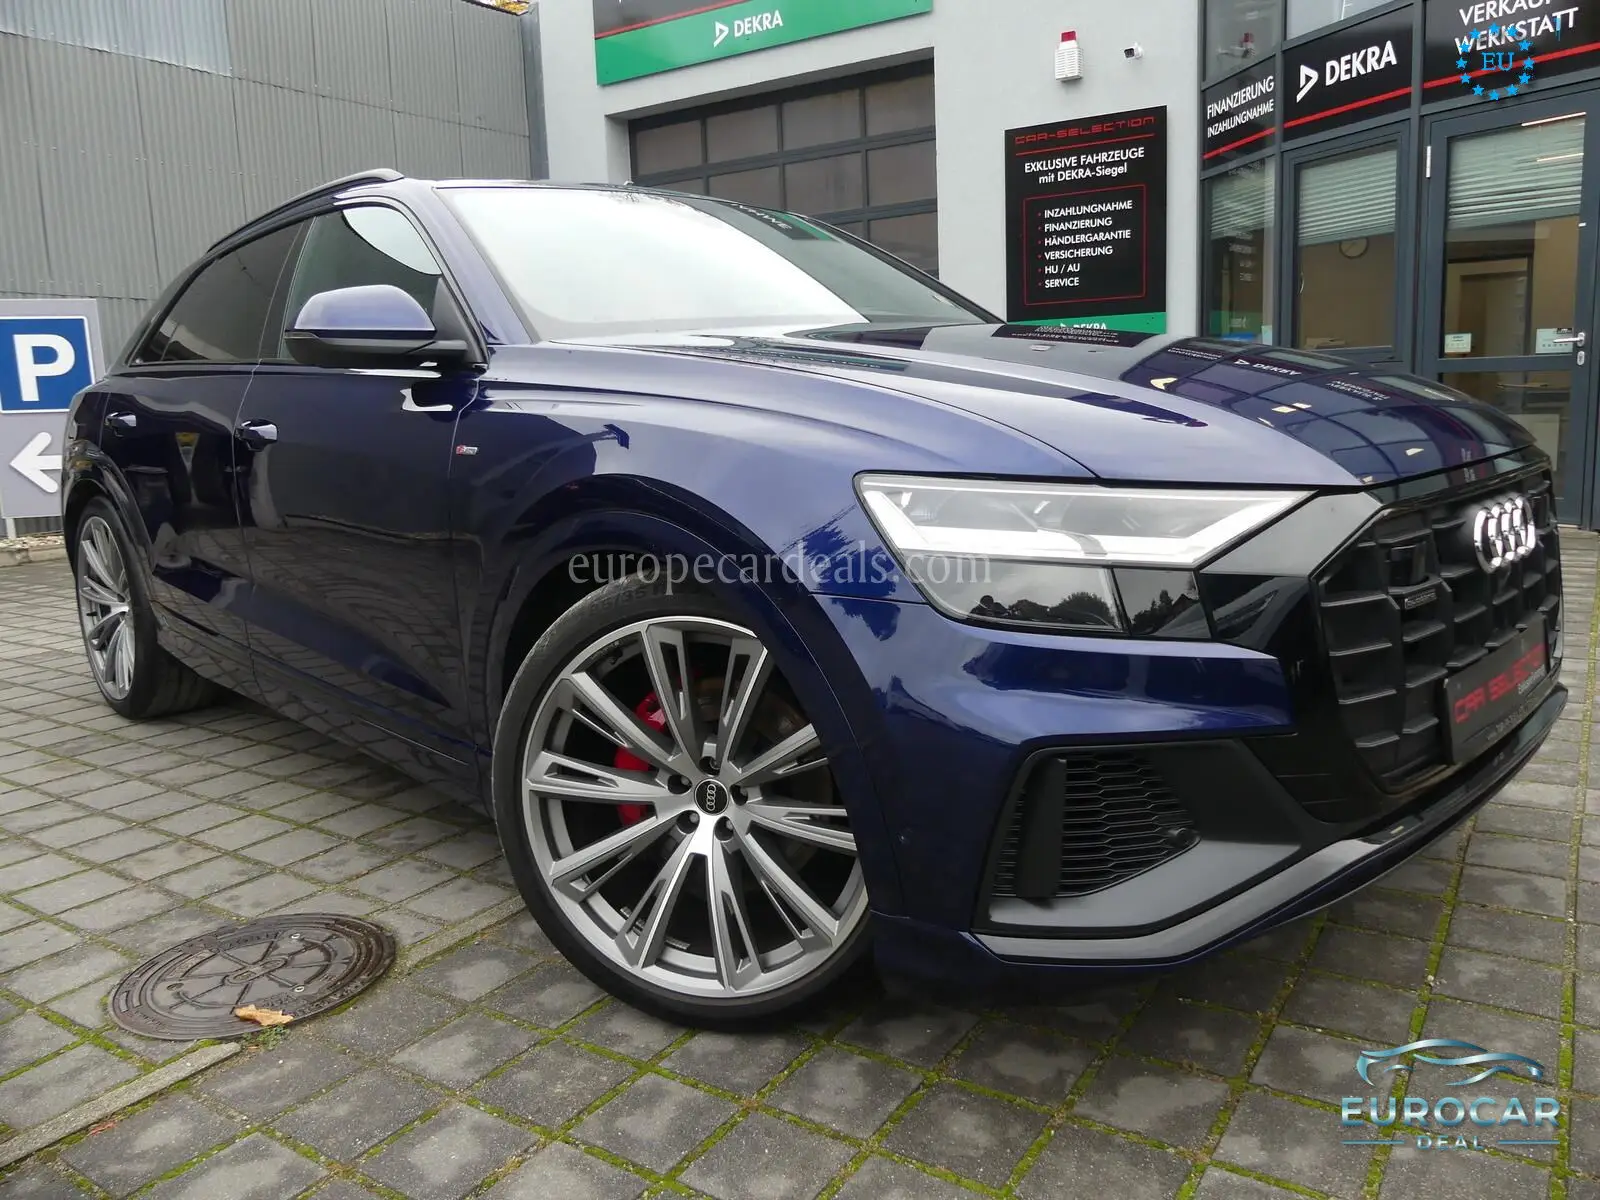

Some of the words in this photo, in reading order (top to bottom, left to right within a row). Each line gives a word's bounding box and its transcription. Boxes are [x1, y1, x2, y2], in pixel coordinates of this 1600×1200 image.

[733, 9, 784, 38] DEKRA
[1454, 7, 1579, 55] WERKSTATT
[1325, 40, 1398, 87] DEKRA
[1207, 75, 1275, 120] FINANZIERUNG
[1015, 116, 1155, 145] CAR-SELECTION
[1207, 99, 1275, 139] INZAHLUNGNAHME
[1024, 156, 1078, 173] EXKLUSIVE
[1080, 147, 1145, 165] FAHRZEUGE
[1038, 173, 1055, 184] mit
[1057, 163, 1128, 182] DEKRA-Siegel
[1044, 200, 1133, 218] INZAHLUNGNAHME
[1044, 217, 1113, 232] FINANZIERUNG
[1044, 229, 1132, 246] HÄNDLERGARANTIE
[1044, 246, 1114, 260] VERSICHERUNG
[1044, 265, 1058, 274] HU
[1067, 263, 1081, 272] AU
[1044, 277, 1080, 288] SERVICE
[13, 334, 76, 402] P
